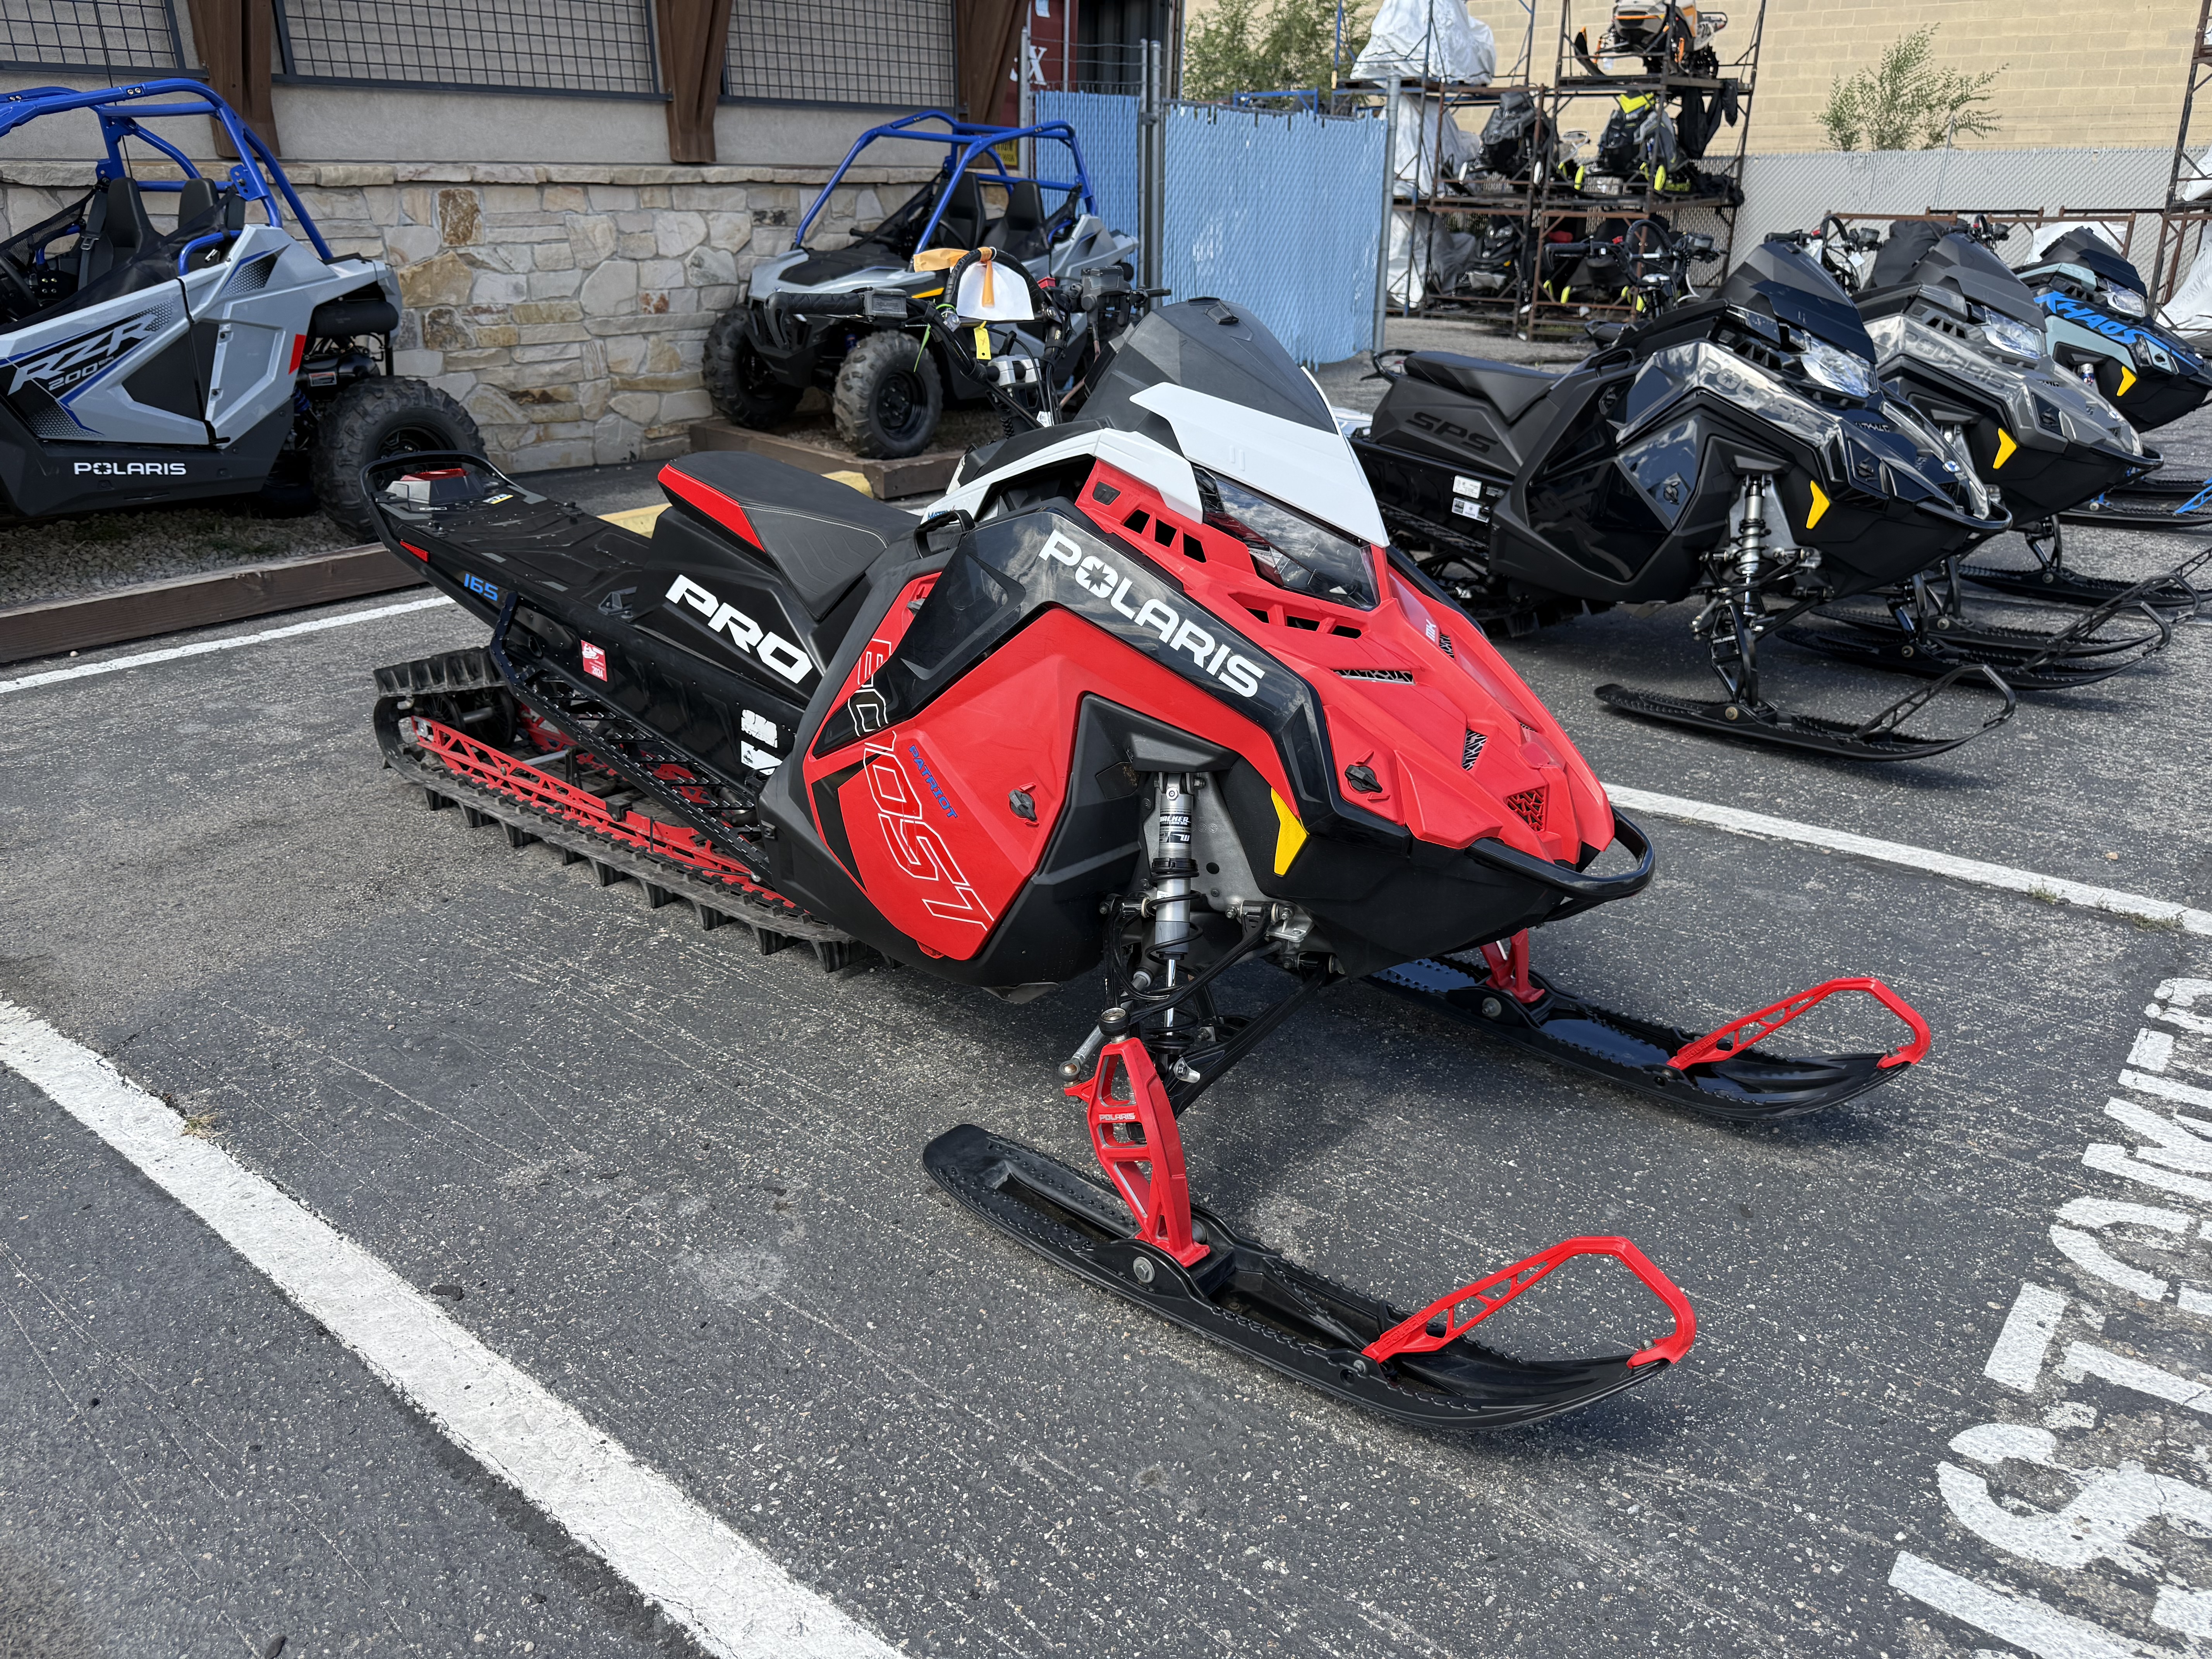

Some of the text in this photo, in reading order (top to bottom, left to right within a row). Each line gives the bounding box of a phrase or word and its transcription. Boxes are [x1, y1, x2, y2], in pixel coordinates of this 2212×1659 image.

[2033, 291, 2150, 345] KHAOS
[7, 314, 158, 396] RZR
[48, 362, 98, 391] 200
[1697, 356, 1822, 434] POLARIS
[1405, 412, 1499, 453] SPS
[74, 462, 187, 475] POLARIS
[465, 573, 498, 601] 165
[665, 574, 813, 684] PRO
[1038, 529, 1266, 697] POLARIS
[591, 666, 603, 678] 2024
[908, 745, 958, 819] PATRIOT
[1684, 1034, 1719, 1060] POLARIS
[1099, 1112, 1135, 1121] POLARIS
[1383, 1312, 1428, 1347] POLARIS
